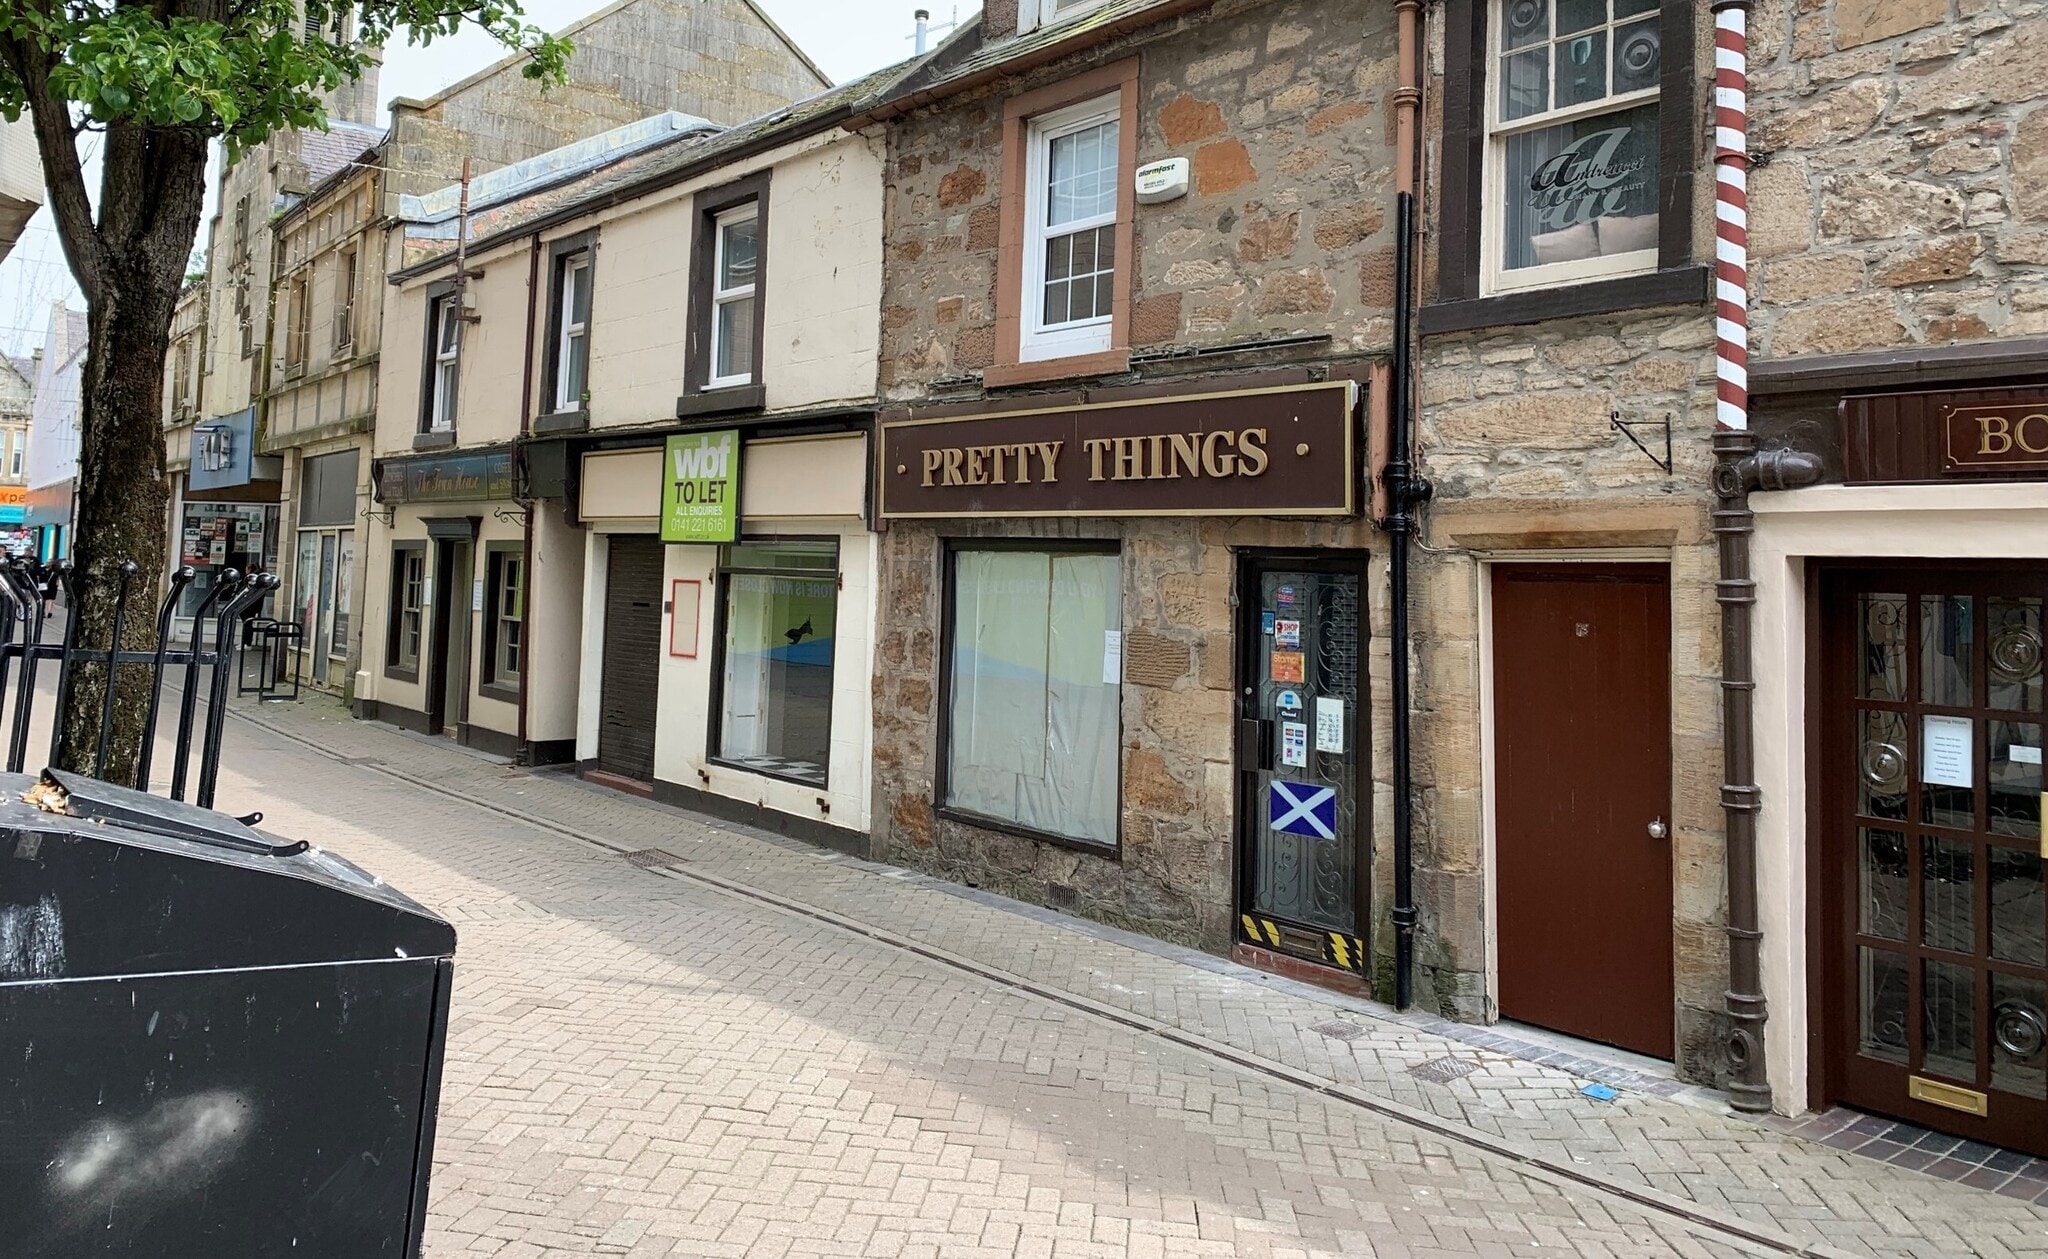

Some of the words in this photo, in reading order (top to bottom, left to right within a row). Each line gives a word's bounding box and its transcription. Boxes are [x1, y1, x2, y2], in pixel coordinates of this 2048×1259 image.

[673, 434, 732, 480] wbf
[920, 441, 1064, 487] PRETTY
[1083, 427, 1268, 482] THINGS
[674, 480, 695, 505] TO
[698, 480, 728, 504] LET
[675, 506, 688, 516] ALL
[689, 505, 723, 516] ENQUIRIES
[671, 518, 690, 532] 0141
[691, 518, 706, 532] 221
[707, 518, 727, 532] 6161
[1283, 623, 1298, 631] SHOP
